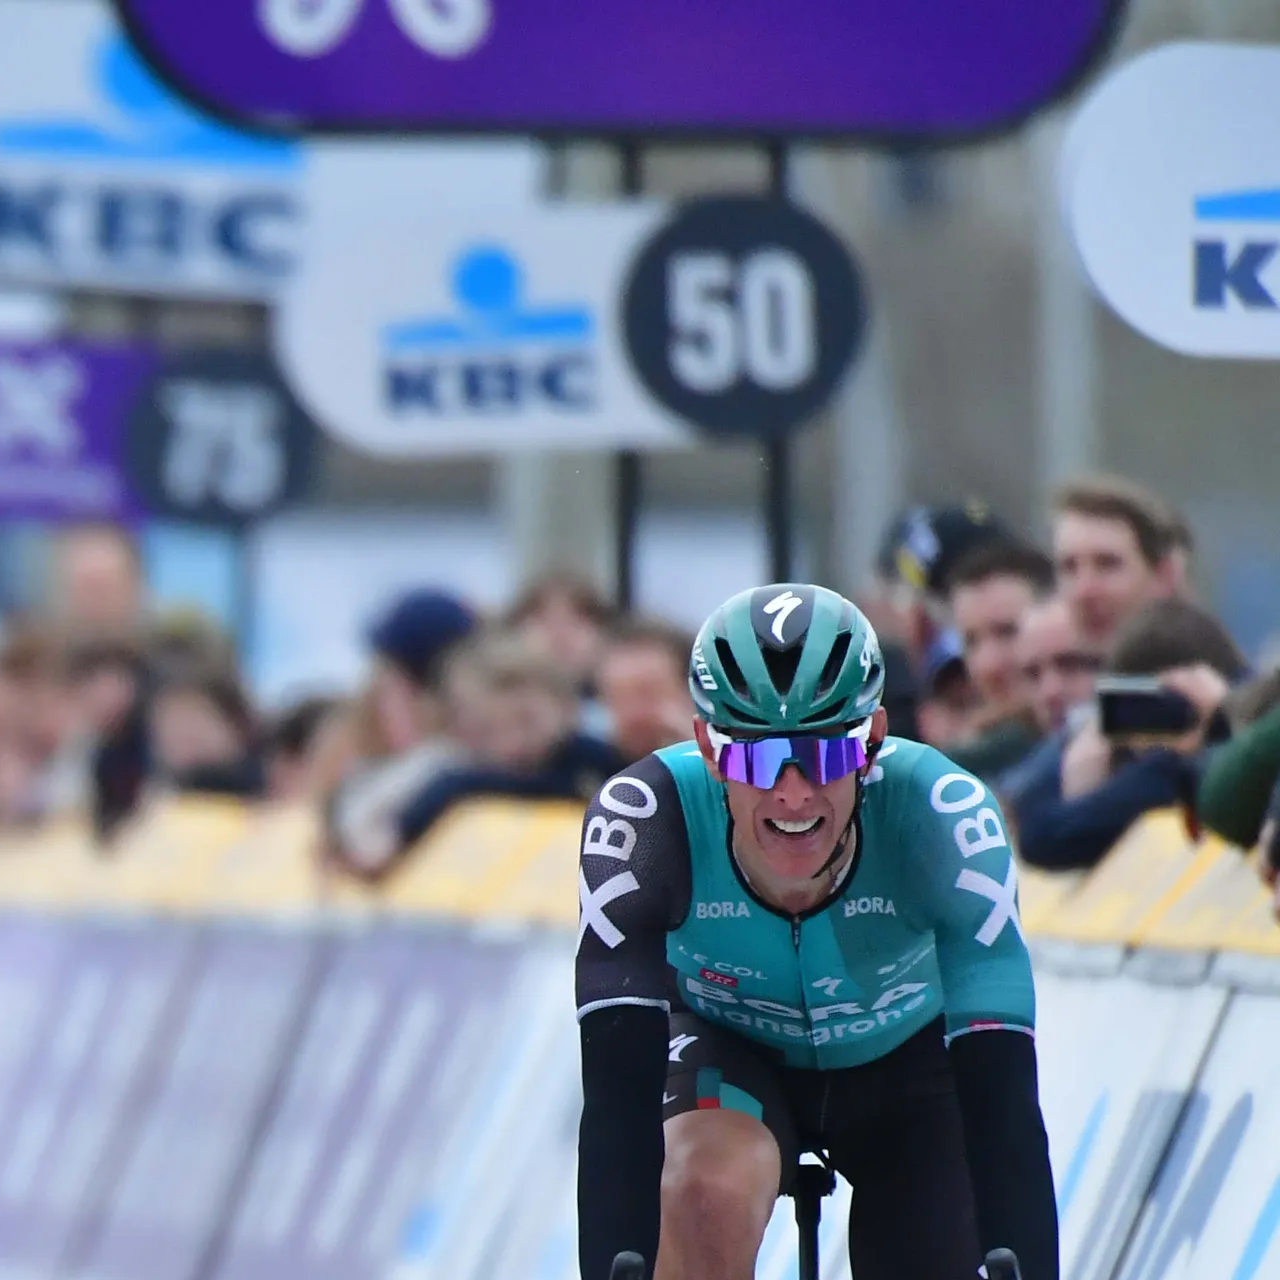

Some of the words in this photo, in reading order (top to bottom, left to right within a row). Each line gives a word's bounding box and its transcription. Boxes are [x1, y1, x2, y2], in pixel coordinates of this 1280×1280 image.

[668, 247, 817, 394] 50
[385, 350, 600, 414] KBC
[160, 378, 286, 506] 75
[696, 901, 750, 919] BORA
[844, 896, 897, 918] BORA
[714, 961, 768, 980] COL
[686, 977, 929, 1022] BORA
